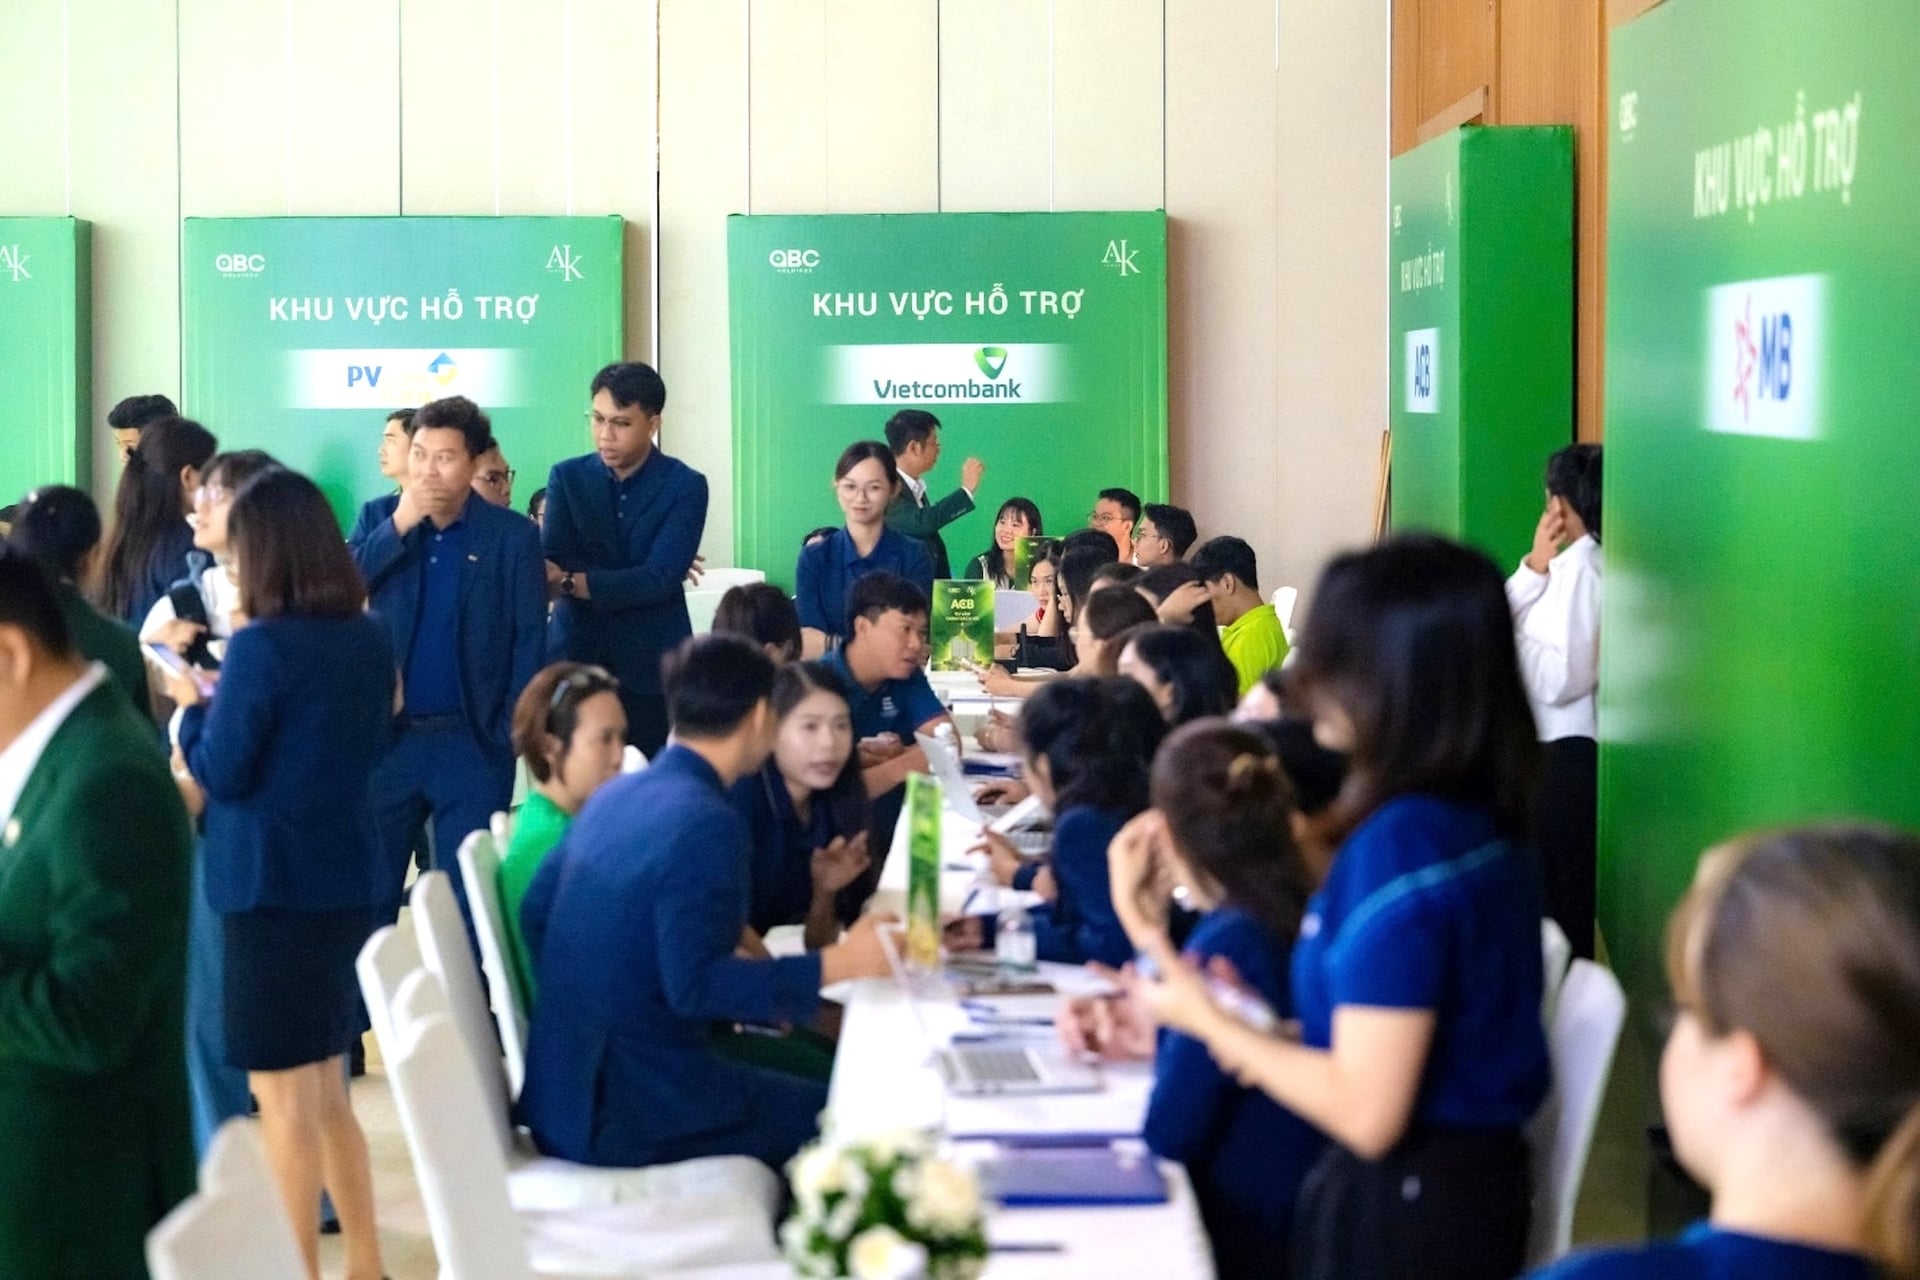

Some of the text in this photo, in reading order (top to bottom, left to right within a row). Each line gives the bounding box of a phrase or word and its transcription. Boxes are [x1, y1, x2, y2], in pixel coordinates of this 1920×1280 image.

[1694, 142, 1732, 220] KHU
[269, 288, 540, 326] KHU VỰC HỖ TRỢ
[813, 283, 1084, 320] KHU VỰC HỖ TRỢ
[1757, 313, 1793, 401] MB
[873, 378, 1022, 399] Vietcombank
[950, 598, 975, 610] ACB
